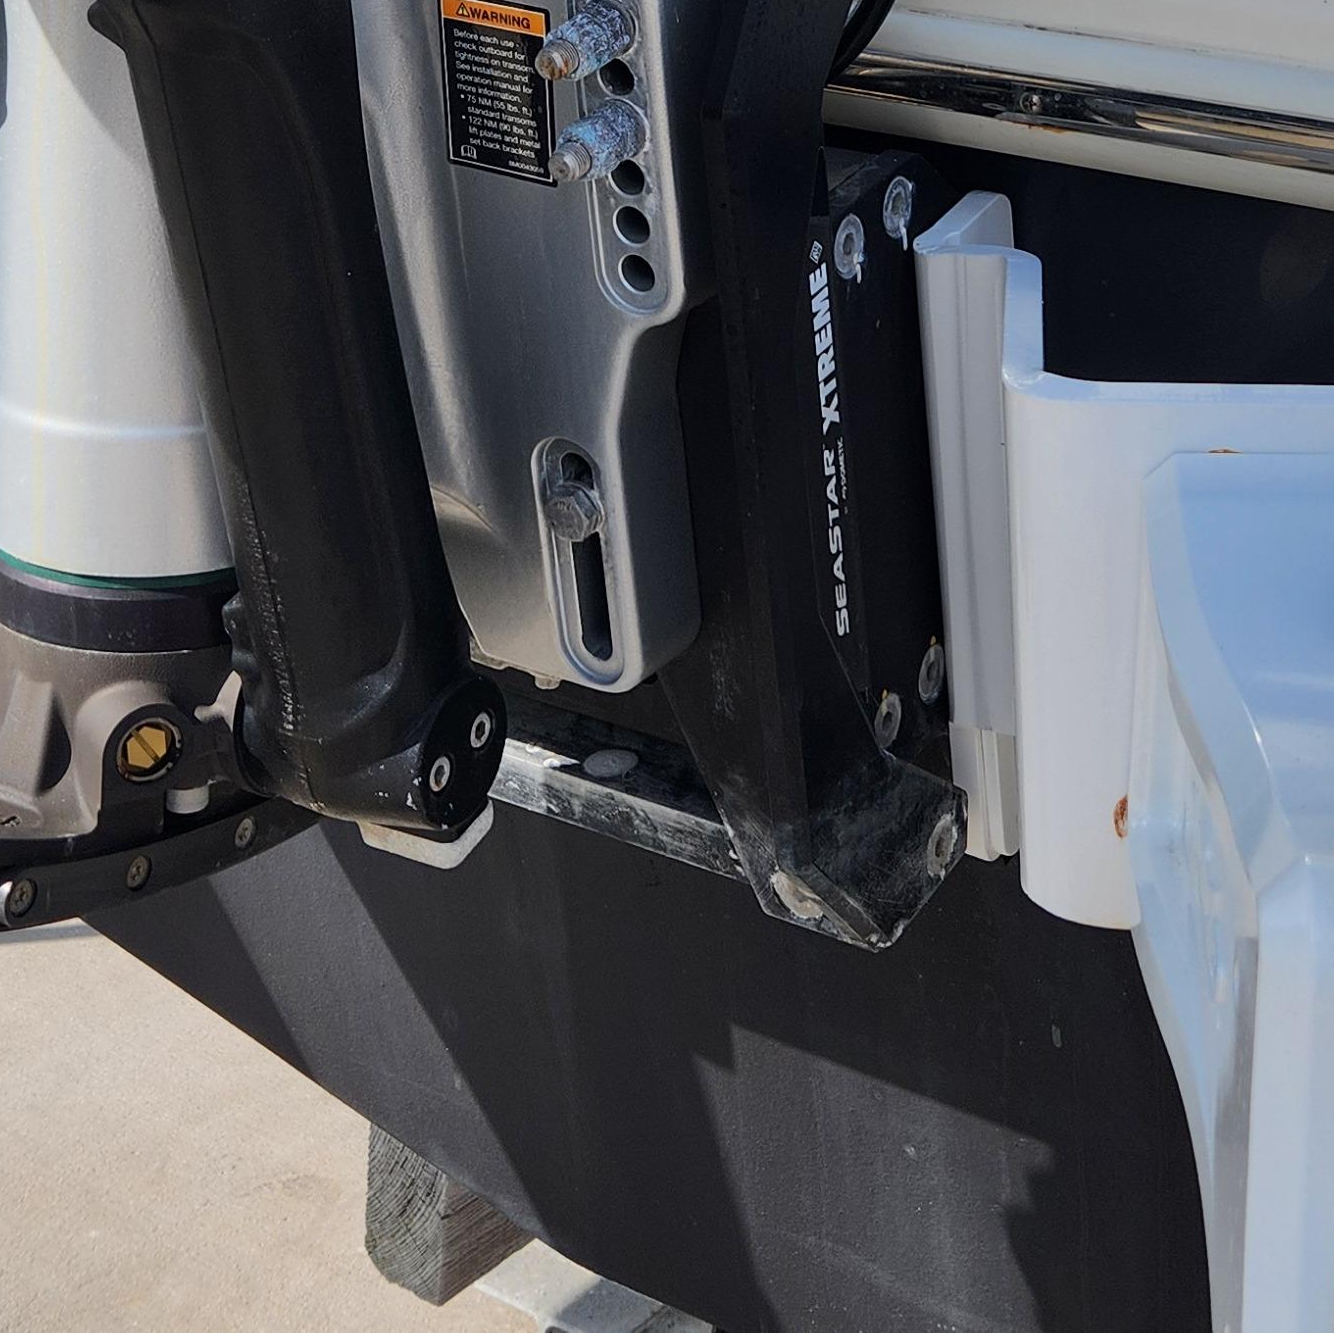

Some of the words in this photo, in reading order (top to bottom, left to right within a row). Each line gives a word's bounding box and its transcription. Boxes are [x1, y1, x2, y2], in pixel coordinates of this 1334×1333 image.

[470, 7, 530, 30] WARNING
[454, 28, 478, 41] Before
[480, 34, 499, 44] each
[454, 40, 477, 51] check
[479, 46, 513, 59] outboard
[515, 51, 525, 60] for
[455, 51, 489, 64] tightness
[456, 61, 470, 71] See
[472, 66, 512, 80] installation
[514, 74, 528, 83] and
[456, 73, 492, 85] operation
[493, 81, 521, 92] manual
[457, 84, 476, 93] more
[467, 94, 476, 103] 75
[478, 97, 492, 106] NM
[493, 100, 505, 110] (55
[468, 106, 500, 119] standard
[502, 113, 537, 127] transoms
[469, 116, 482, 126] 122
[484, 118, 497, 128] NM
[499, 122, 511, 132] (90
[469, 126, 478, 135] lift
[480, 129, 502, 140] plates
[504, 135, 518, 144] and
[520, 139, 541, 149] metal
[482, 139, 501, 150] back
[502, 146, 535, 158] brackets
[808, 262, 841, 436] XTREME
[823, 448, 850, 637] SEASTAR
